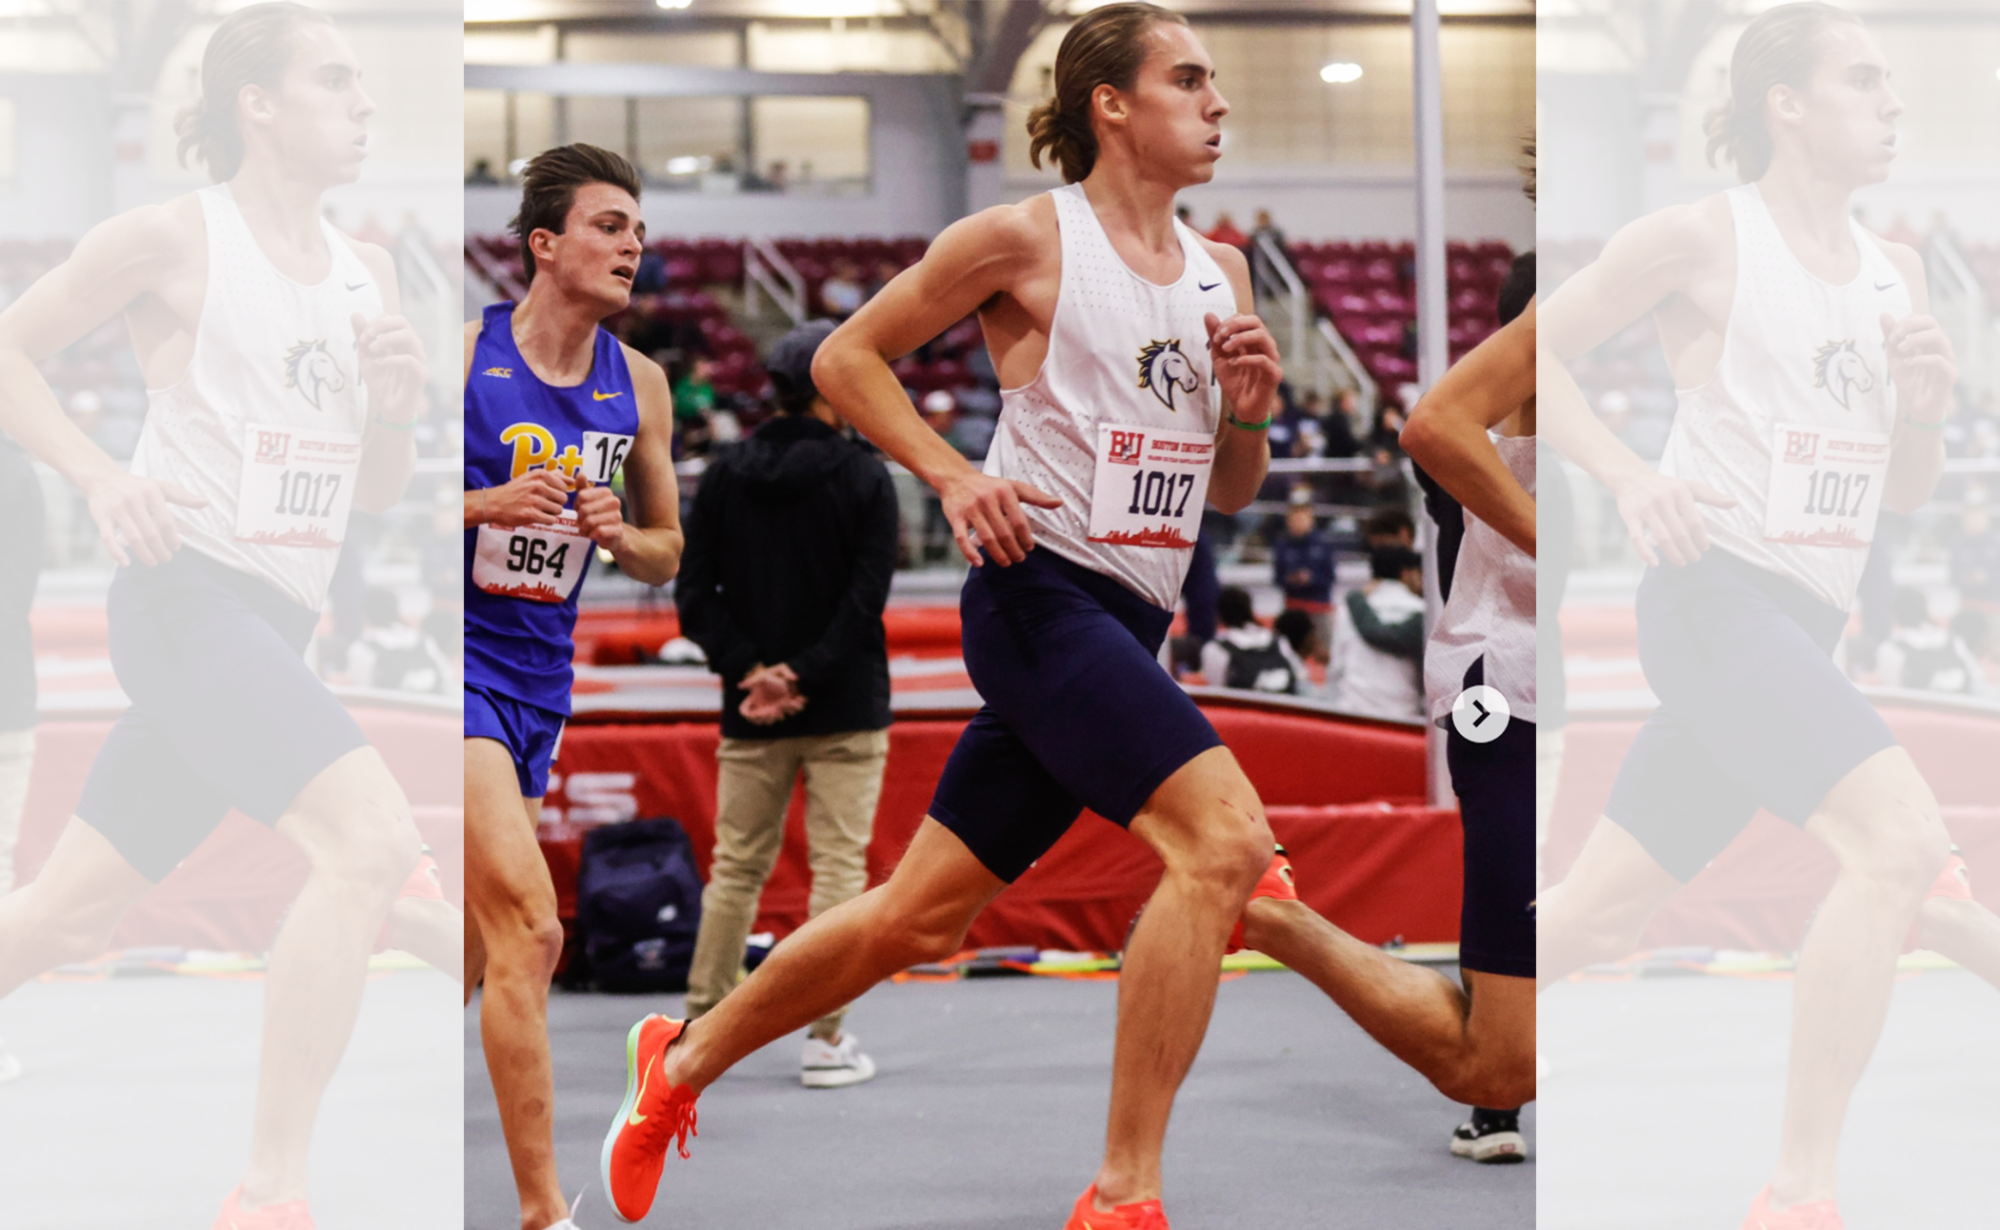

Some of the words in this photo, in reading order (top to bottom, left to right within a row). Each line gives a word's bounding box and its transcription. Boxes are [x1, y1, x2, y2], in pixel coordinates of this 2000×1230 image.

[500, 422, 596, 492] Pt
[596, 437, 629, 479] 16
[1109, 431, 1145, 459] BU
[275, 469, 342, 518] 1017
[1128, 469, 1195, 518] 1017
[1803, 469, 1871, 518] 1017
[507, 535, 570, 579] 964
